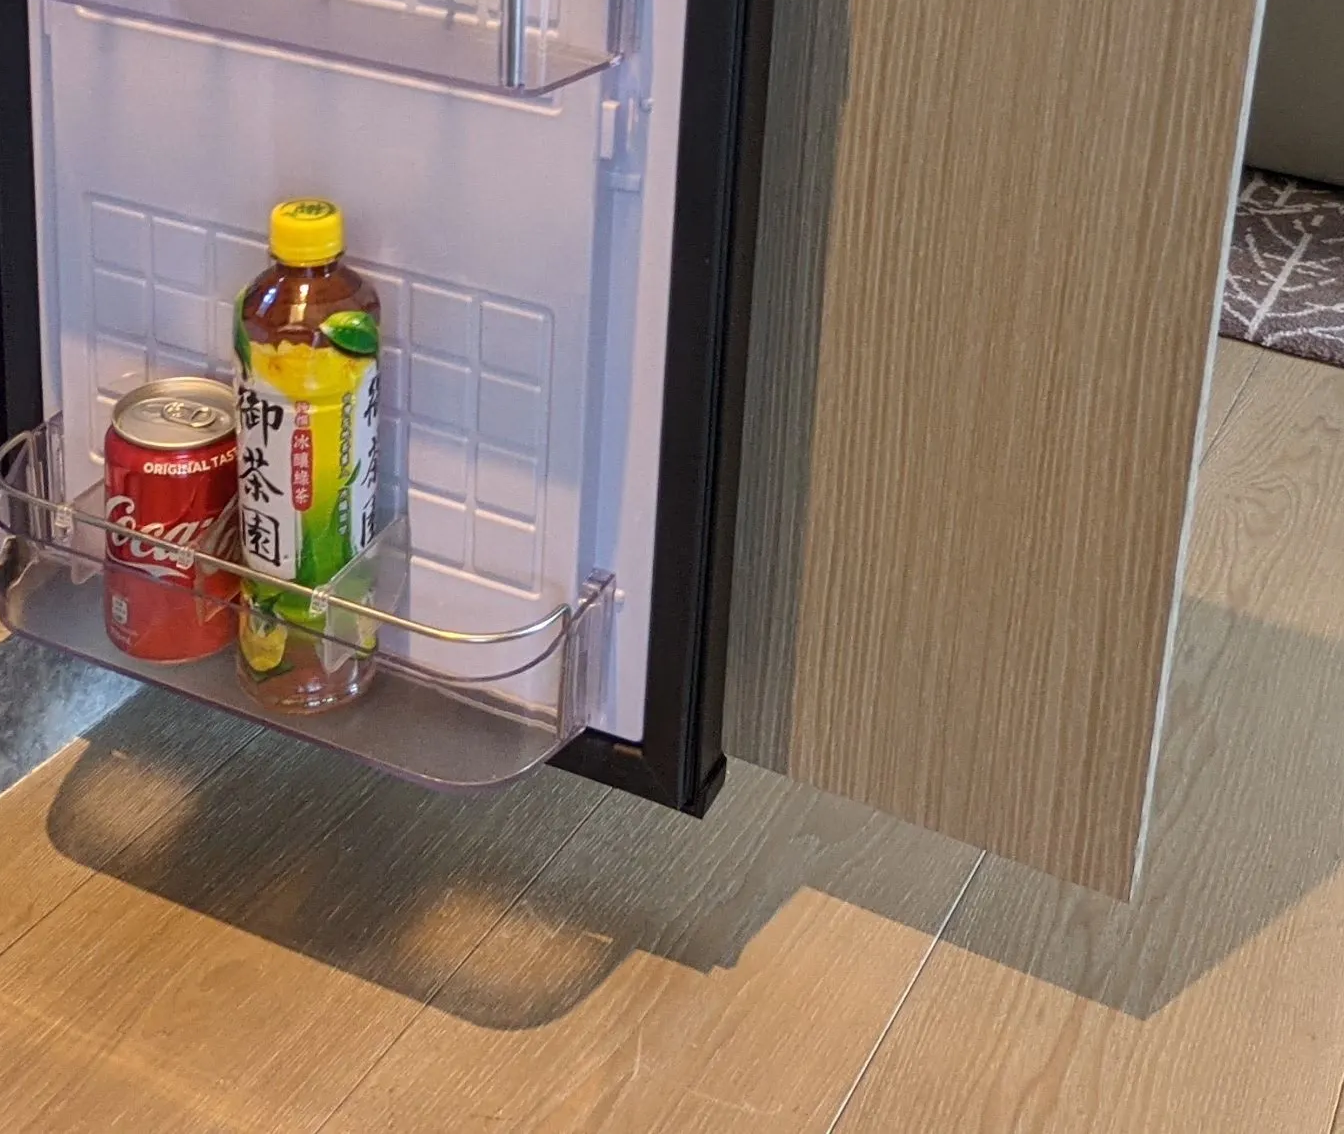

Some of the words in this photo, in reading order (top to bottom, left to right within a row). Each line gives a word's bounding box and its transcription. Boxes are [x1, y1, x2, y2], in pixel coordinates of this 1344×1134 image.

[143, 461, 211, 475] ORIGINAL
[239, 387, 285, 567] 御茶園
